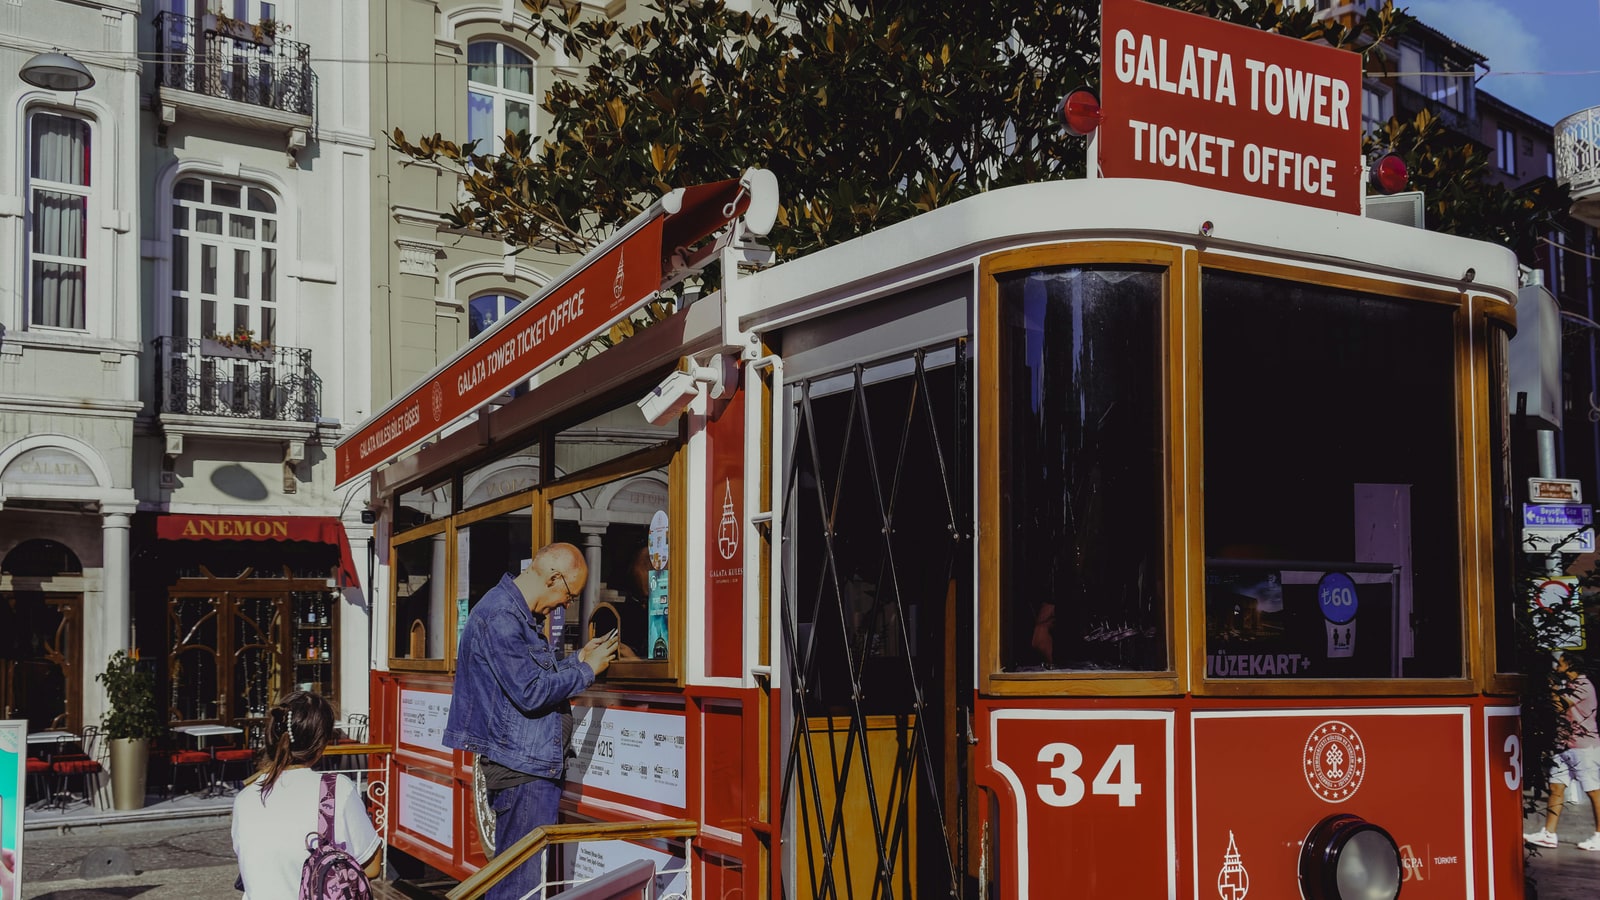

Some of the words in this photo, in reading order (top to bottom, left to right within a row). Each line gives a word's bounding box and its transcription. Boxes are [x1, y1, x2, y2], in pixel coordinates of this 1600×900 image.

[1115, 28, 1237, 106] GALATA
[1245, 58, 1350, 131] TOWER
[1129, 119, 1235, 177] TICKET
[1243, 143, 1337, 198] OFFICE
[457, 359, 486, 397] GALATA
[487, 338, 516, 377] TOWER
[516, 314, 548, 357] TICKET
[548, 288, 585, 336] OFFICE
[21, 461, 80, 476] GALATA
[360, 435, 376, 459] GALATA
[182, 519, 289, 537] ANEMON
[1036, 742, 1142, 808] 34
[1504, 734, 1523, 791] 3
[1433, 856, 1458, 865] TÜRKİYE
